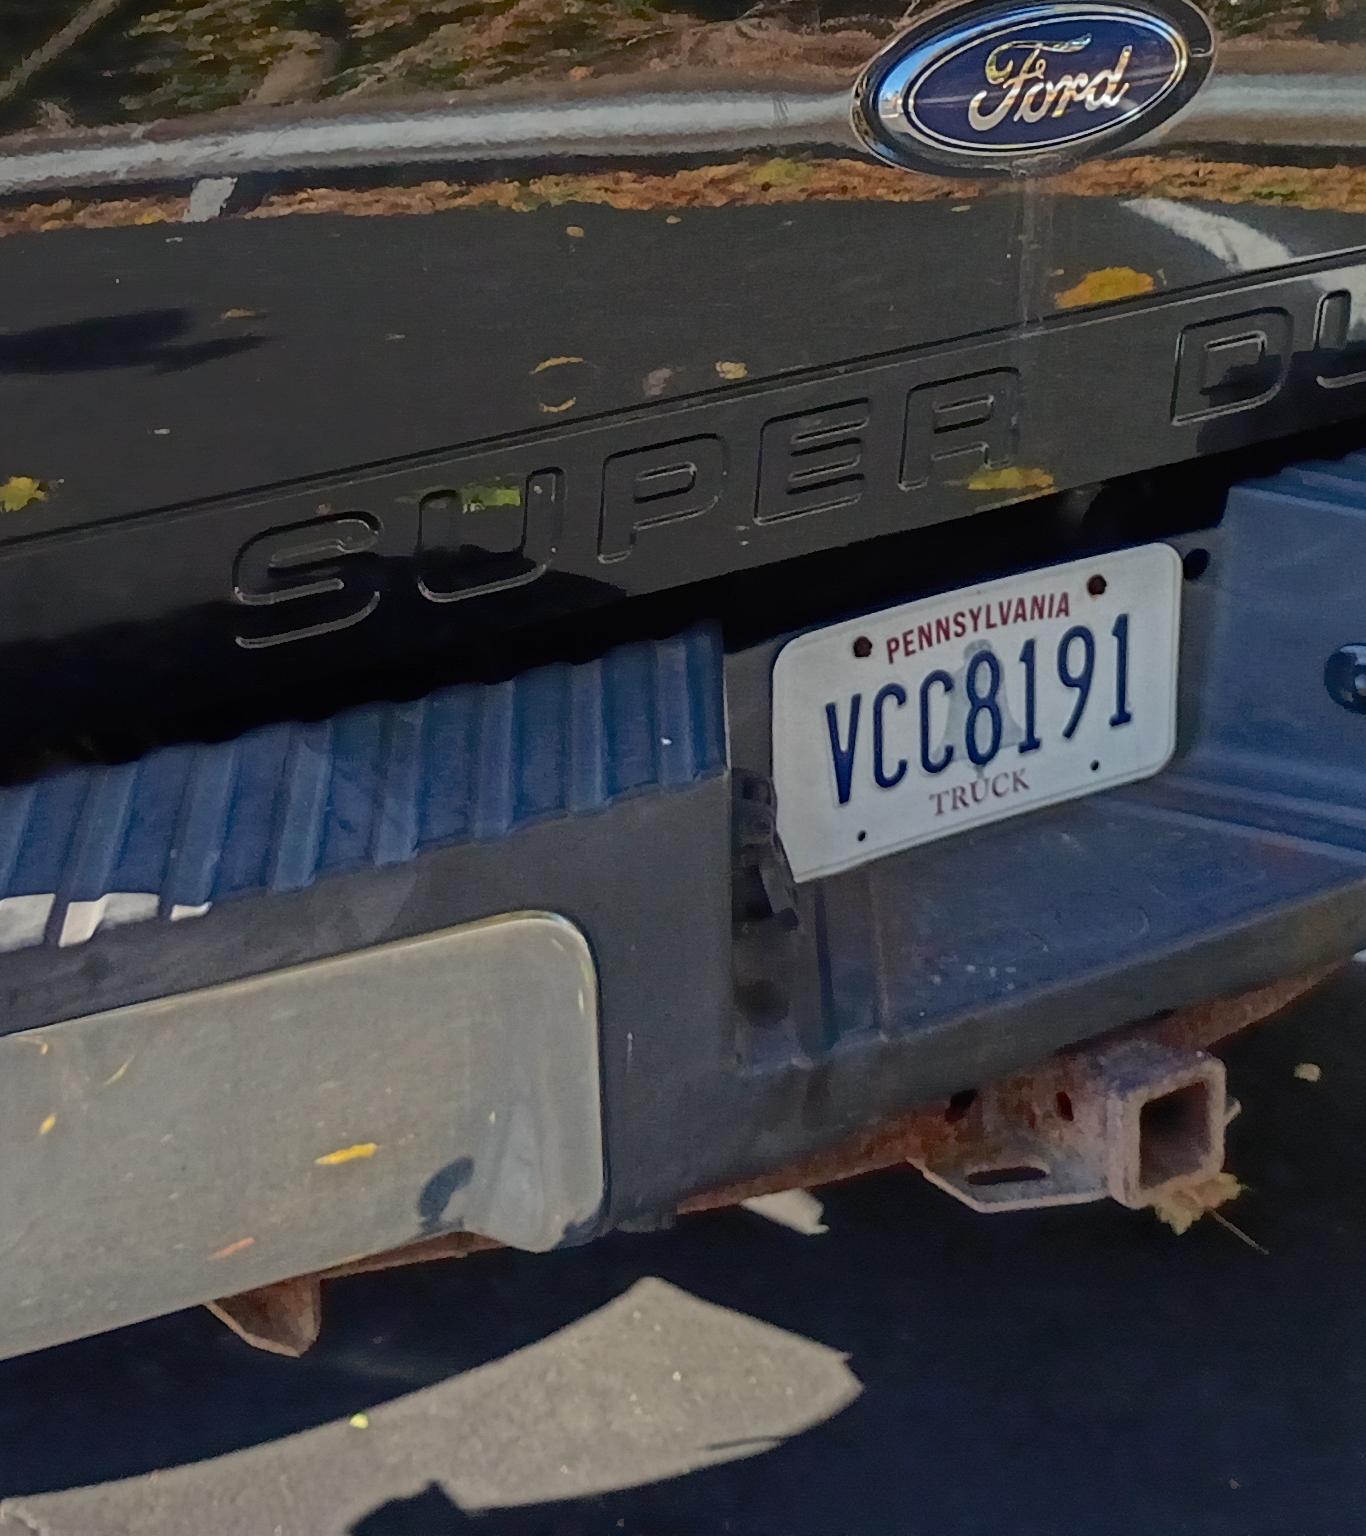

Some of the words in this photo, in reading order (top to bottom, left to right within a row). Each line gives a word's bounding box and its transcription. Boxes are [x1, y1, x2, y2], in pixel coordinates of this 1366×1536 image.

[968, 33, 1133, 132] Ford
[232, 366, 1021, 649] SUPER
[886, 591, 1071, 664] PENNSYLVANIA
[825, 613, 1132, 805] VCC8191
[928, 768, 1031, 817] TRUCK
